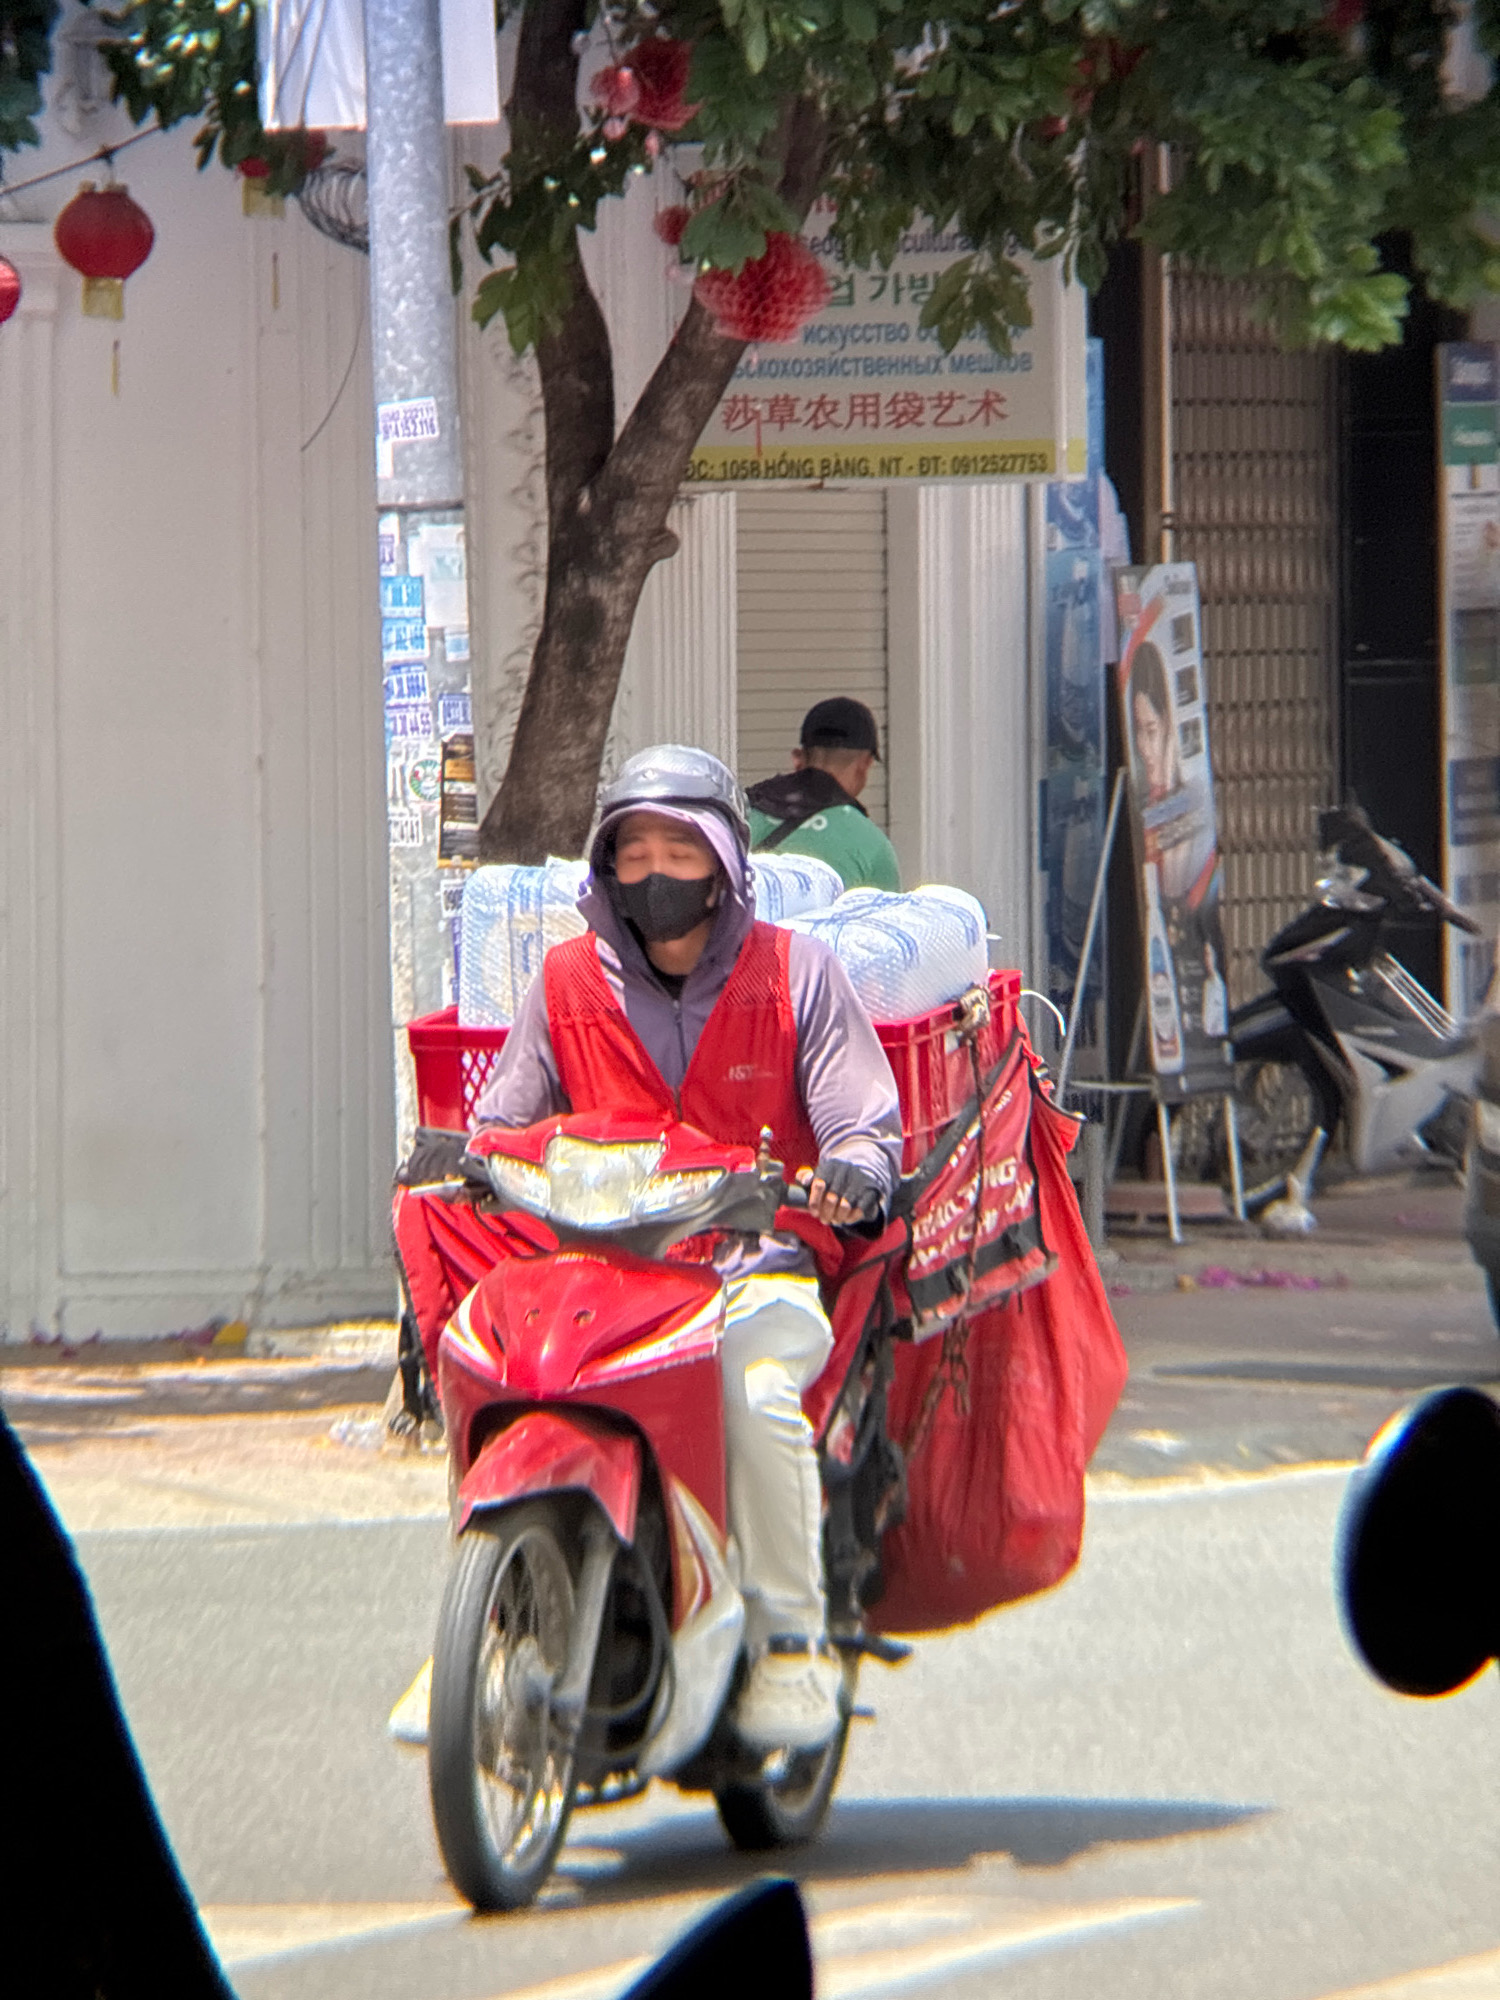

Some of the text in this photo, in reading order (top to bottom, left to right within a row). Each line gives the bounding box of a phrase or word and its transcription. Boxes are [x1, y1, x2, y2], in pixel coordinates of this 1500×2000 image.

[802, 322, 910, 355] искусство
[734, 354, 943, 379] ьскохозяйственных
[722, 389, 1009, 432] 莎草农用袋艺术
[879, 456, 903, 477] NT
